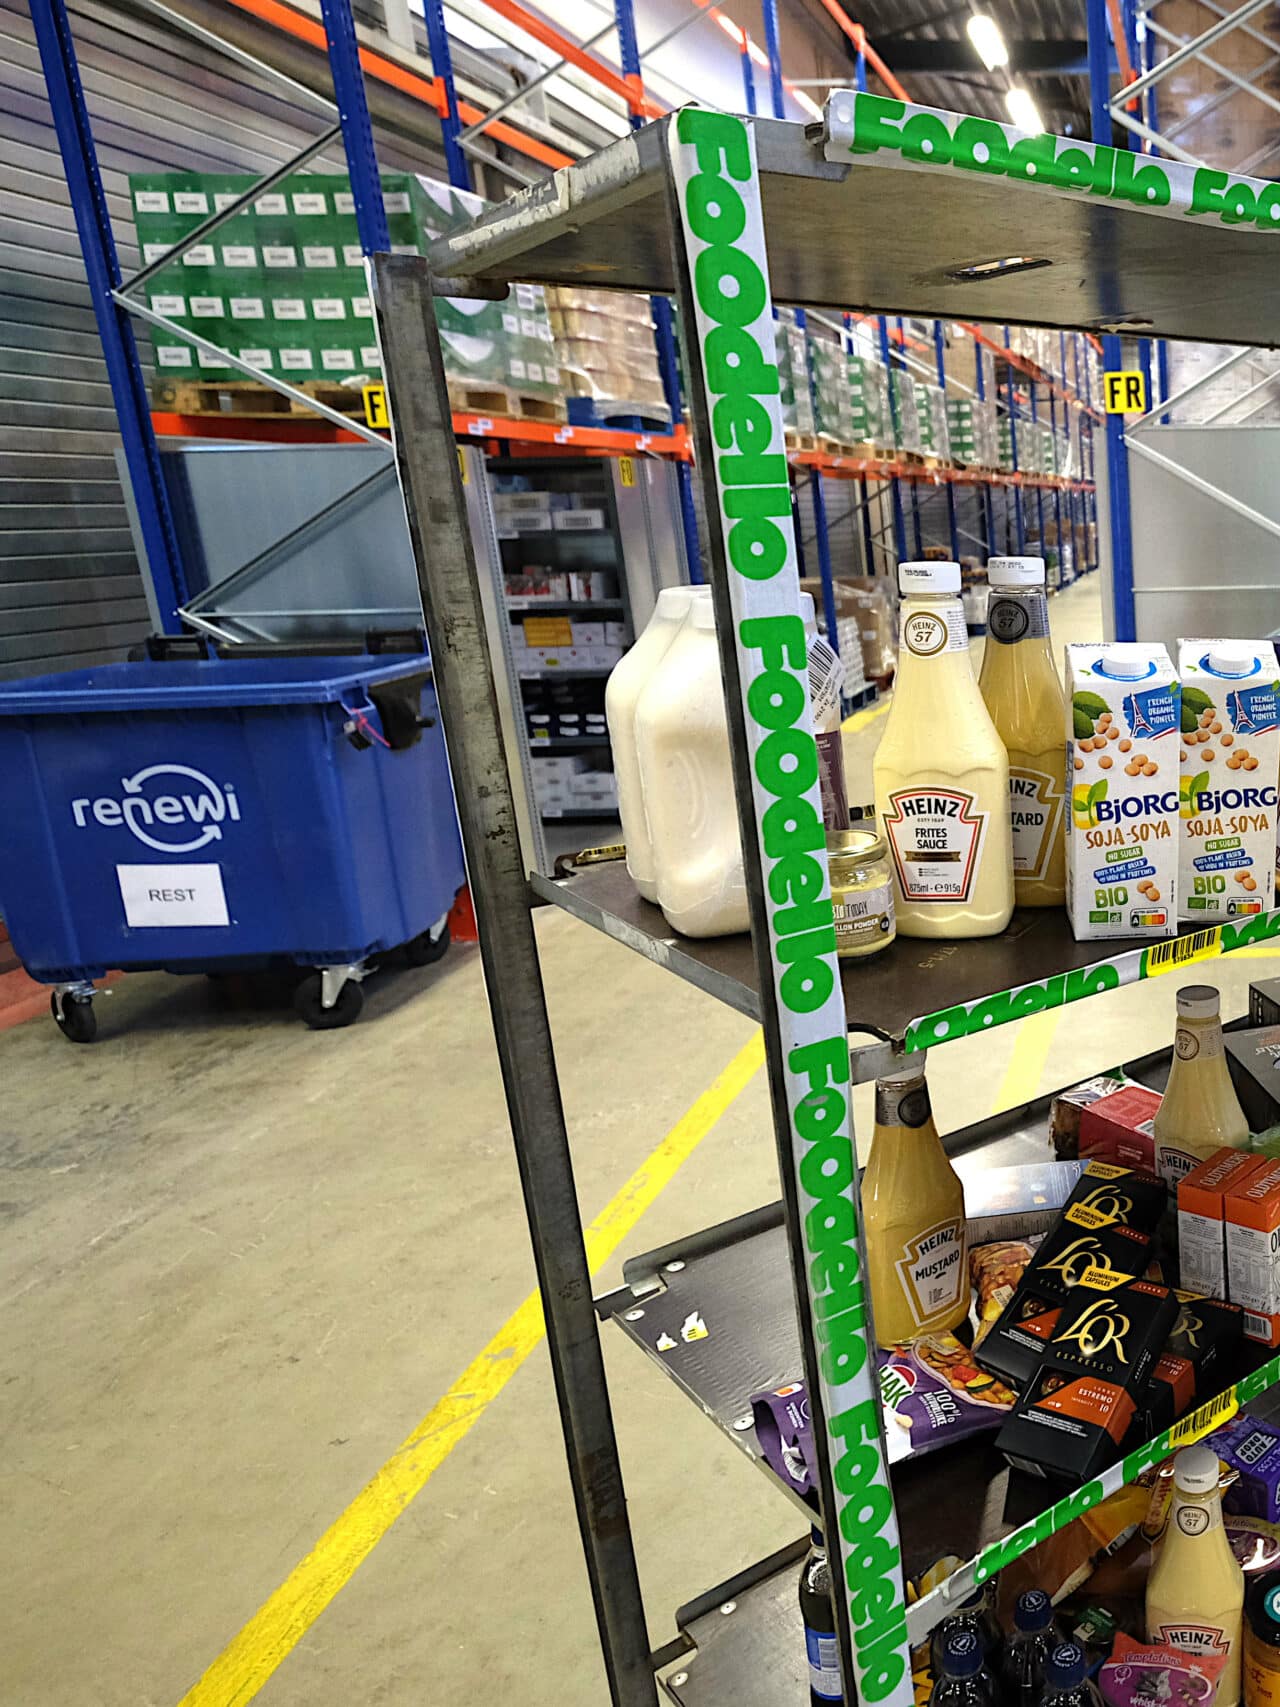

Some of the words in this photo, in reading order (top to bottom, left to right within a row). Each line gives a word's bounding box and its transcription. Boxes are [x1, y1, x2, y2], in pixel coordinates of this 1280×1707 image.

[1109, 378, 1142, 408] FR
[911, 621, 936, 632] HEINZ
[914, 631, 932, 643] 57
[1009, 778, 1037, 798] INZ
[71, 784, 241, 829] renewi
[902, 797, 960, 818] HEINZ
[1011, 811, 1044, 826] TARD
[1186, 813, 1269, 838] SOJA-SOYA
[915, 828, 948, 839] FRITES
[1085, 820, 1171, 849] SOJA-SOYA
[917, 839, 948, 850] SAUCE
[148, 888, 196, 903] REST
[1193, 875, 1226, 895] BIO
[1094, 886, 1129, 909] BIO
[1200, 1152, 1251, 1187] OLDTIMERS
[918, 1227, 955, 1256] HEINZ
[915, 1250, 960, 1281] MUSTARD
[1056, 1351, 1113, 1373] ESPRESSO
[1078, 1387, 1113, 1403] ESTREMO
[934, 1388, 962, 1424] 100%
[1239, 1435, 1261, 1457] DROP
[1245, 1441, 1268, 1463] AUTO
[1184, 1519, 1199, 1527] 57
[1169, 1631, 1214, 1646] HEINZ
[1123, 1653, 1182, 1666] Temptations
